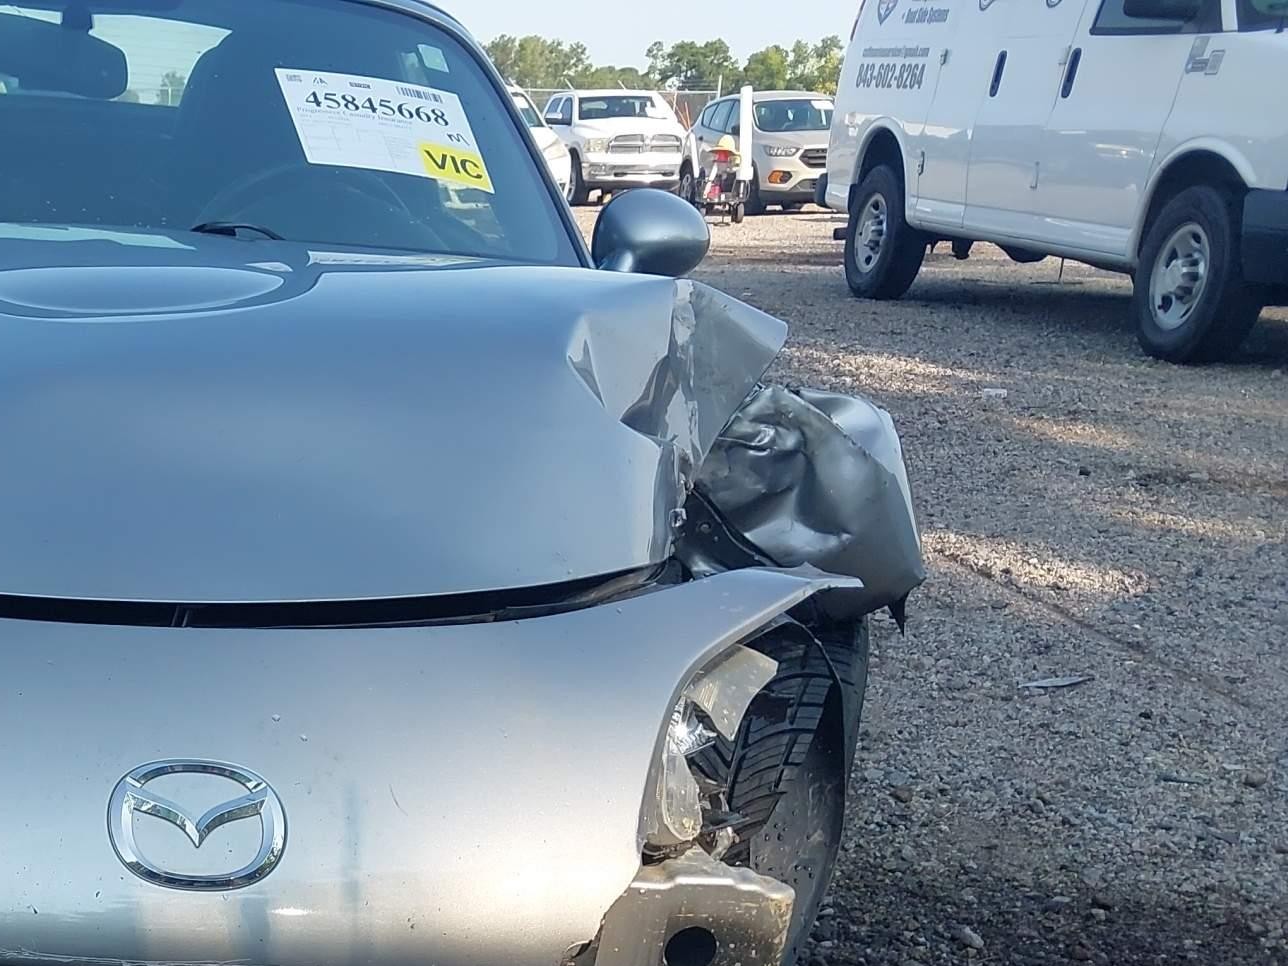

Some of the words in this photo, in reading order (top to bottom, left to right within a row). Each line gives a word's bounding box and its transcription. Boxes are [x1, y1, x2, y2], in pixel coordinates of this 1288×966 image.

[855, 63, 926, 90] 843-602-8264
[305, 91, 449, 127] 45845668
[424, 149, 483, 179] VIC
